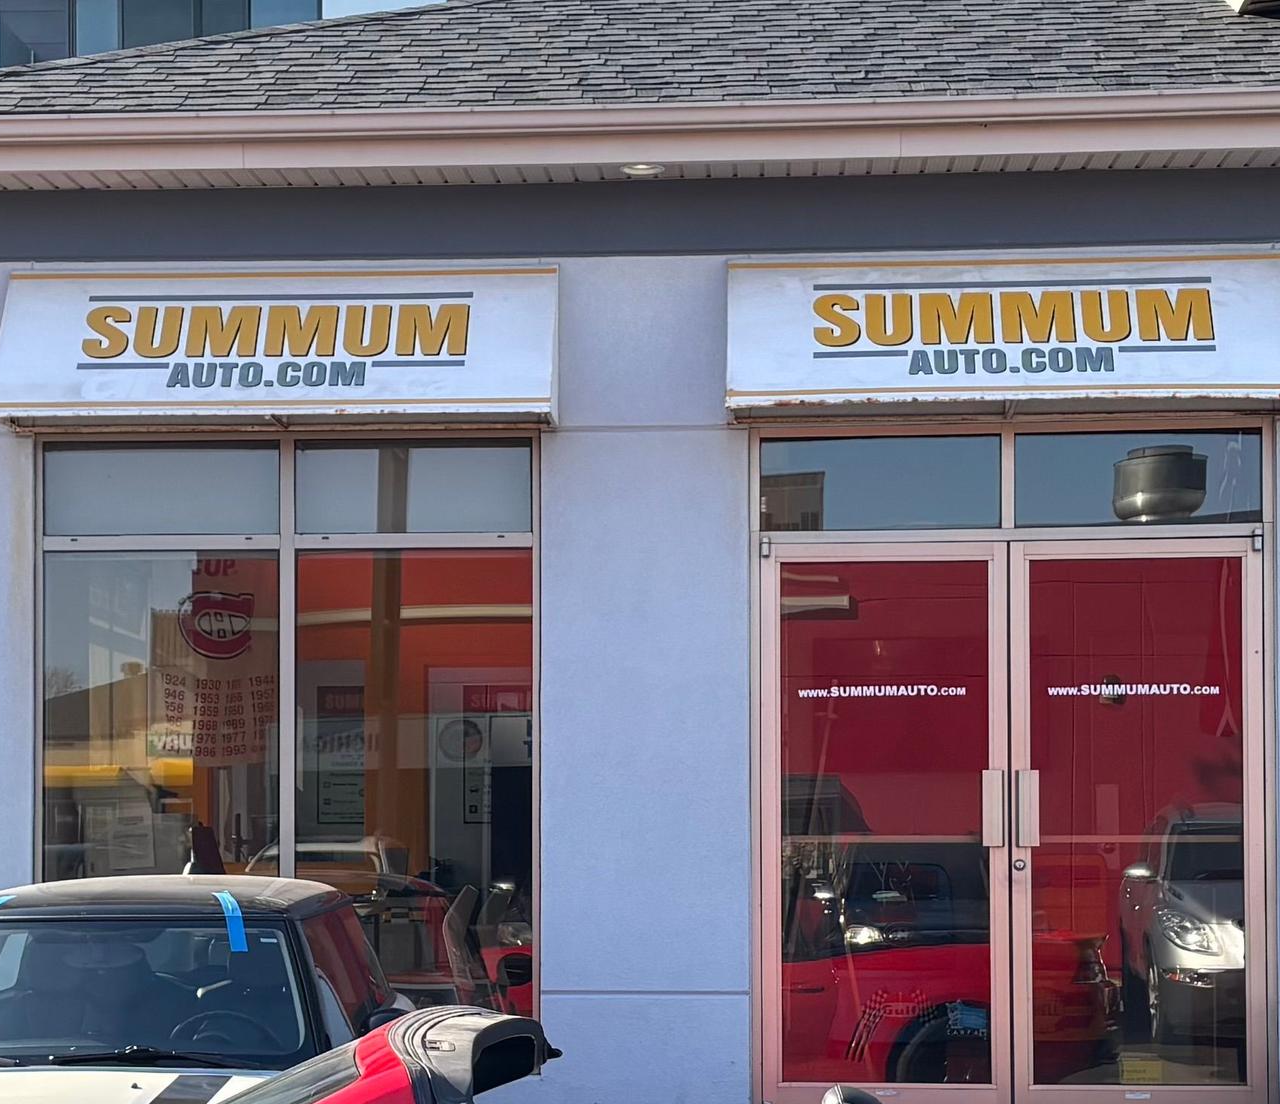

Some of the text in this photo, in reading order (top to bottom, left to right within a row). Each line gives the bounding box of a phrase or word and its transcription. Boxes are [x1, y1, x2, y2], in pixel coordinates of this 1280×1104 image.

[81, 303, 471, 359] SUMMUM
[813, 288, 1215, 347] SUMMUM
[167, 361, 366, 388] AUTO.COM
[908, 347, 1115, 375] AUTO.COM
